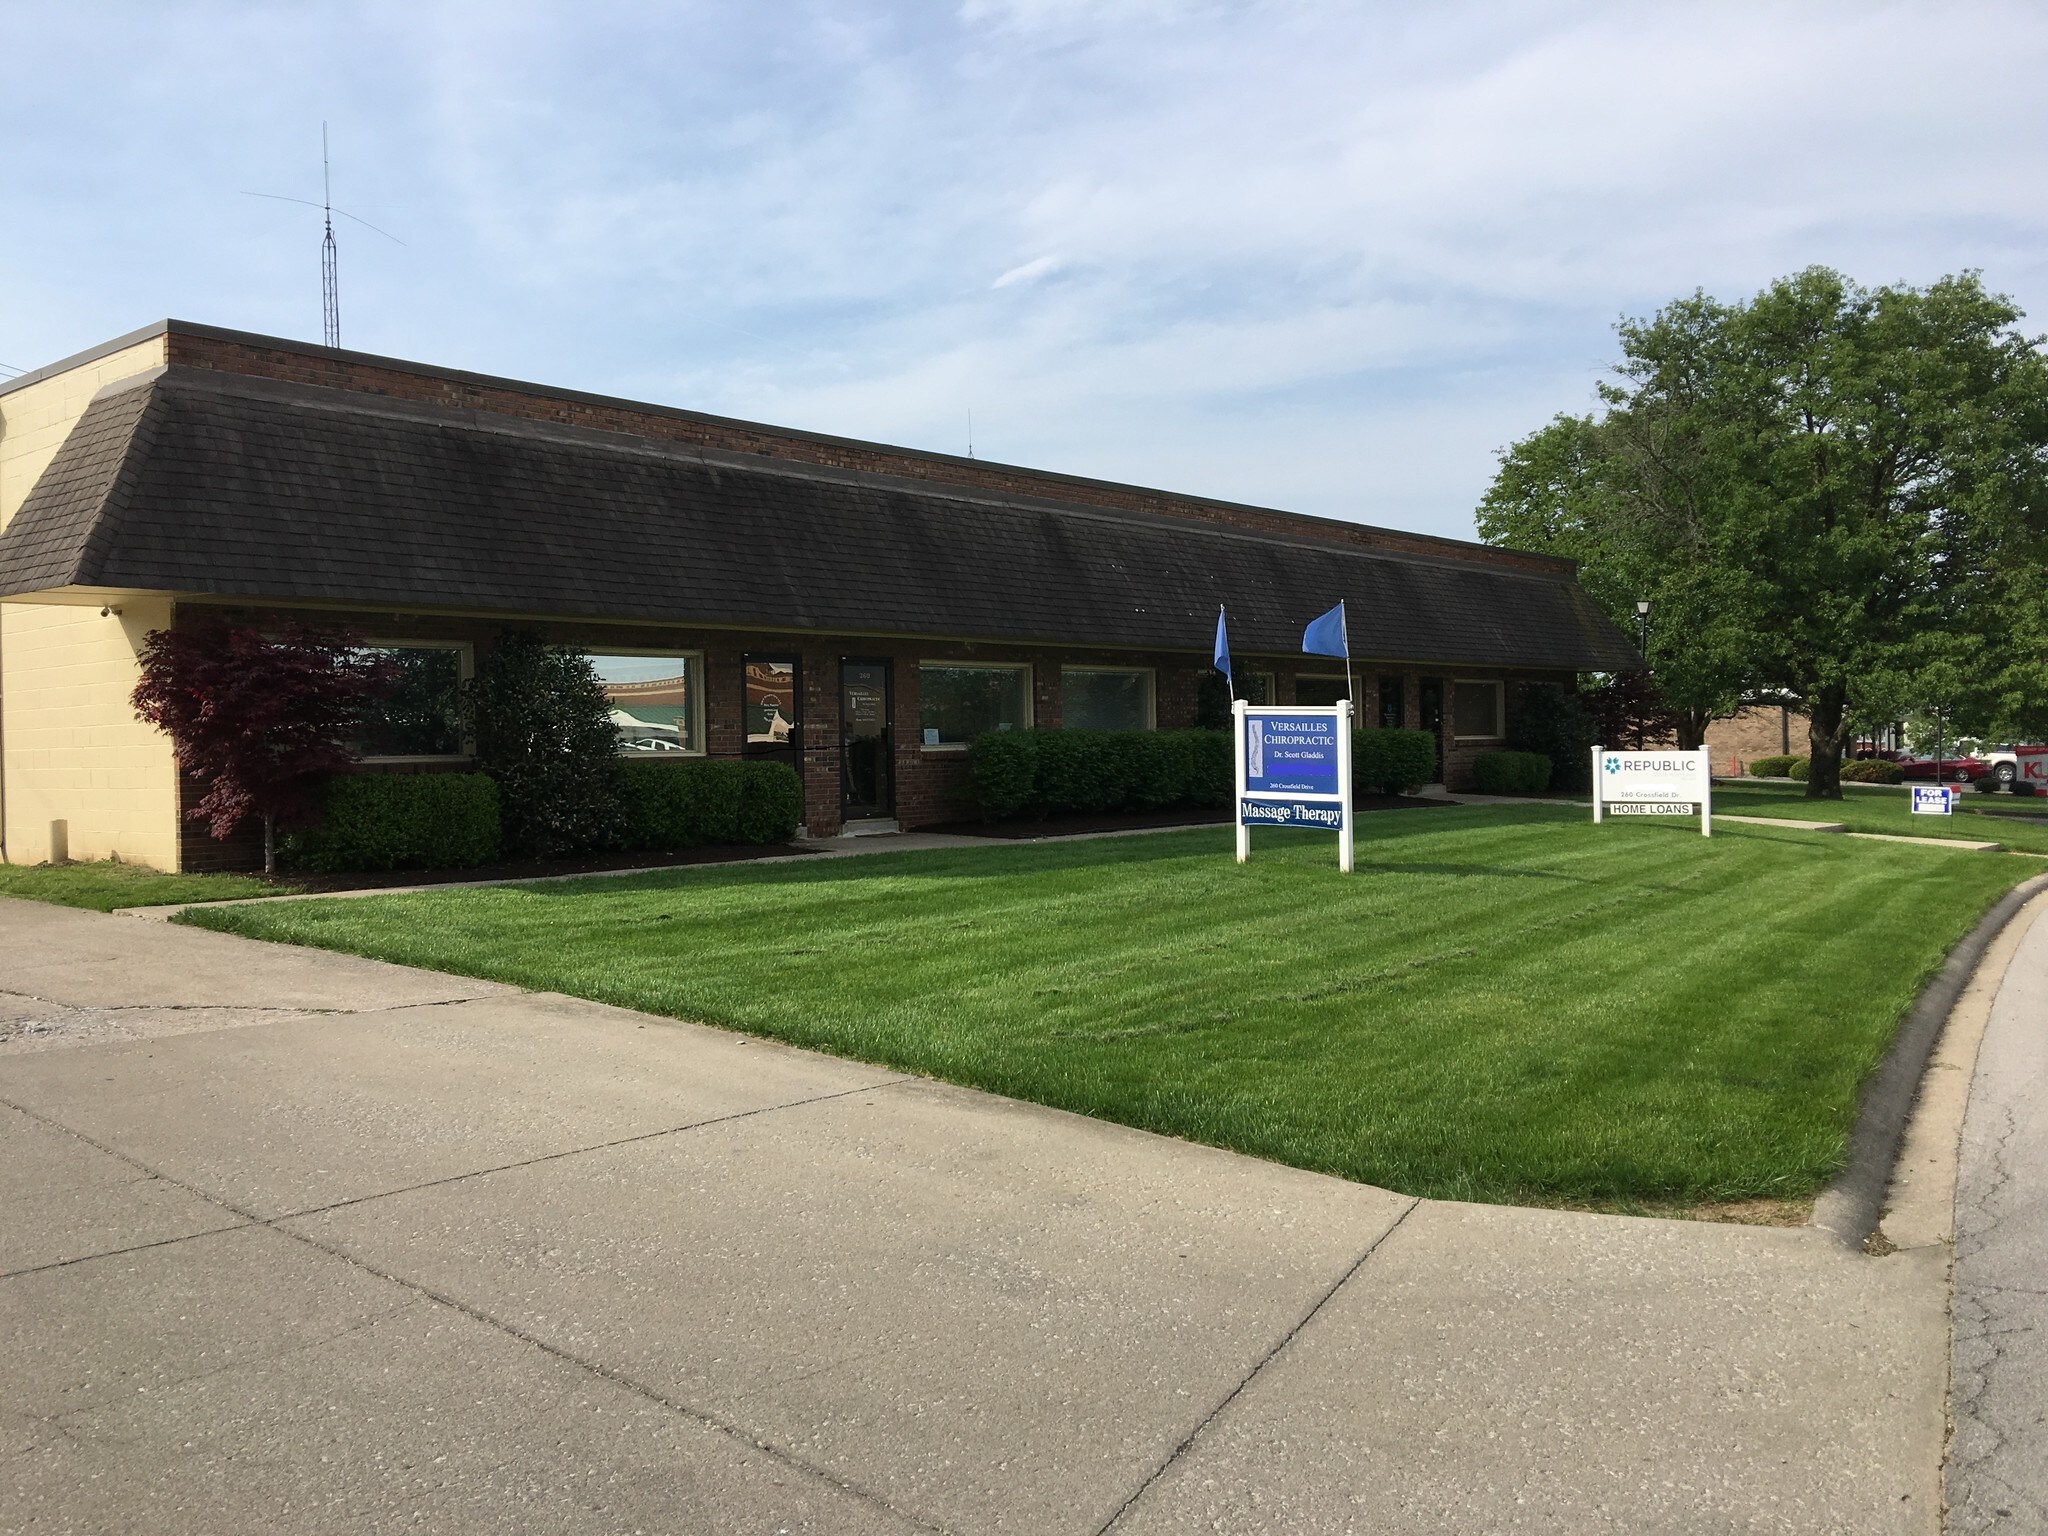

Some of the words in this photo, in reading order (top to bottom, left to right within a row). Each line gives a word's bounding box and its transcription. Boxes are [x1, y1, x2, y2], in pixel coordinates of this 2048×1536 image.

[1270, 721, 1328, 732] VERSAILLES
[1264, 734, 1334, 745] CHIROPRACTIC
[1274, 750, 1284, 758] Dr.
[1284, 750, 1300, 759] Scott
[1300, 751, 1325, 760] Gladdis
[1624, 760, 1696, 771] REPUBLIC
[1920, 789, 1942, 797] FOR
[1242, 803, 1291, 822] Massage
[1293, 805, 1342, 825] Therapy
[1613, 804, 1647, 814] HOME
[1649, 804, 1690, 814] LOANS
